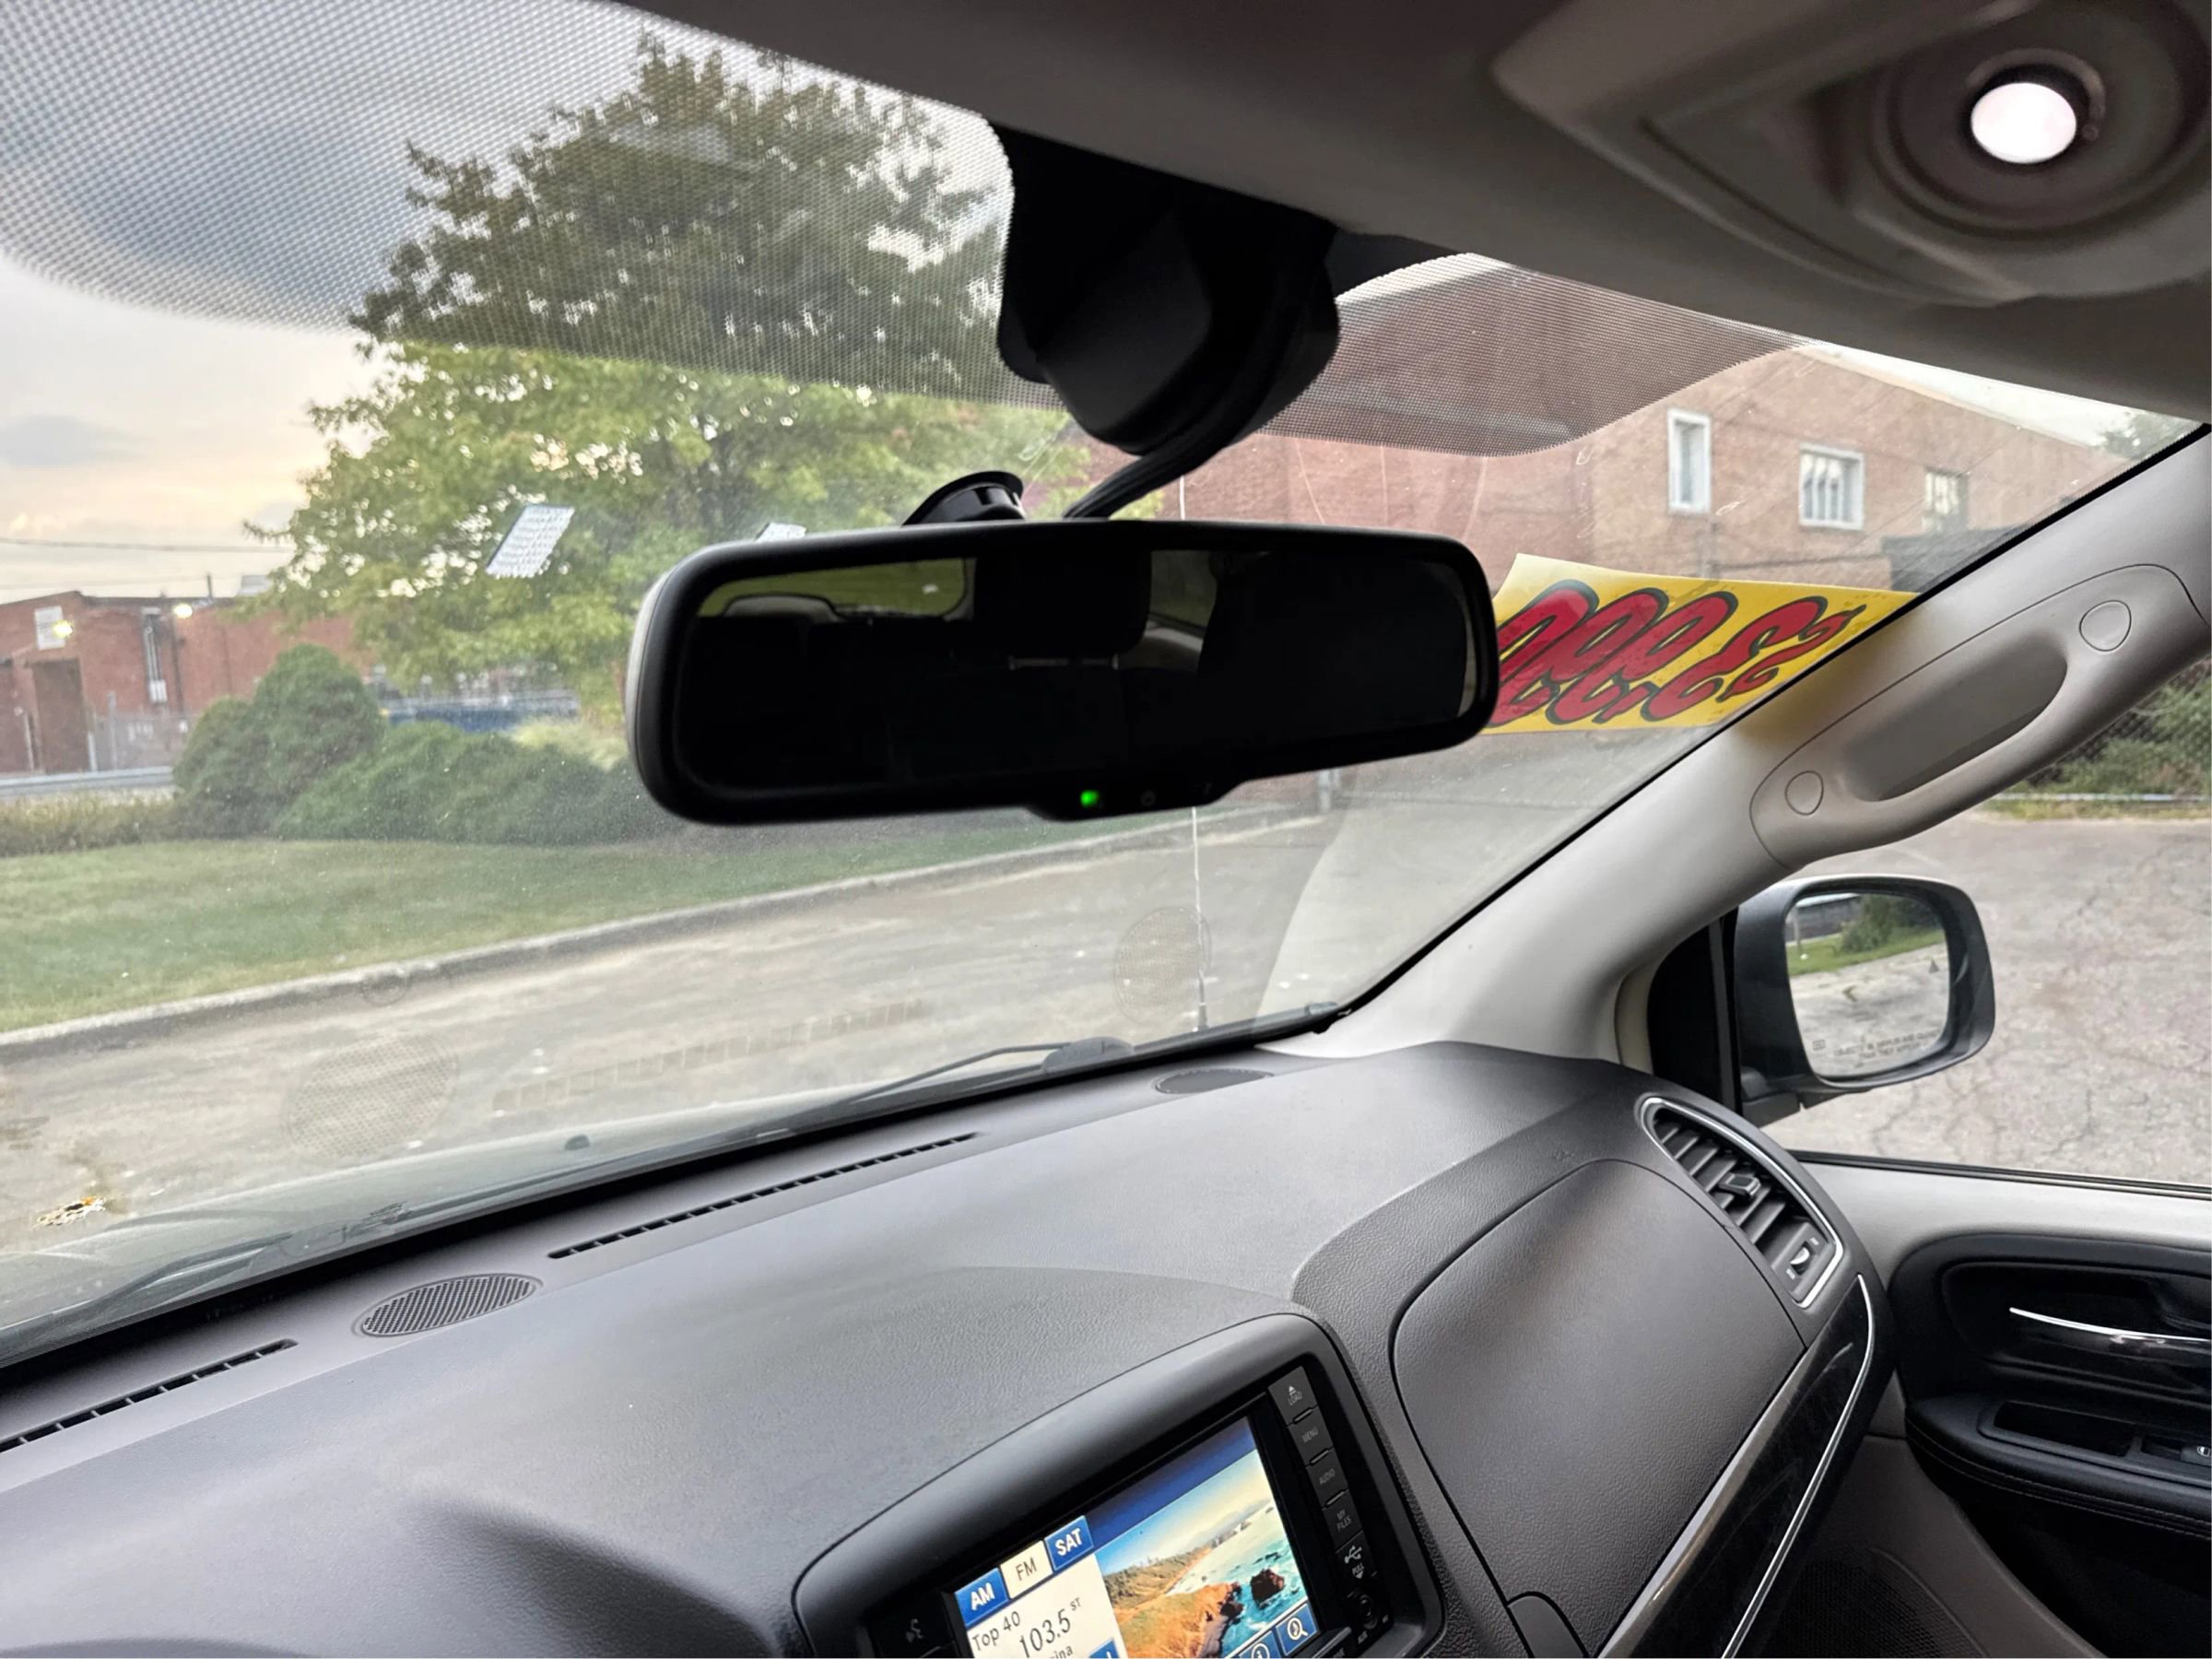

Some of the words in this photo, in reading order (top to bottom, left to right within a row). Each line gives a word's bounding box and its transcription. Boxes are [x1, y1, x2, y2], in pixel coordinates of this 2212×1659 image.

[1288, 1391, 1303, 1406] LOAD
[1301, 1426, 1319, 1443] MENU
[1319, 1468, 1335, 1485] AUDIO
[1336, 1515, 1352, 1532] FILES
[1055, 1528, 1083, 1556] SAT
[1016, 1557, 1038, 1582] FM
[970, 1582, 995, 1612] AM
[971, 1626, 1000, 1653] Top
[1003, 1611, 1021, 1631] 40
[1019, 1608, 1071, 1658] 103.5
[1070, 1597, 1081, 1612] ST
